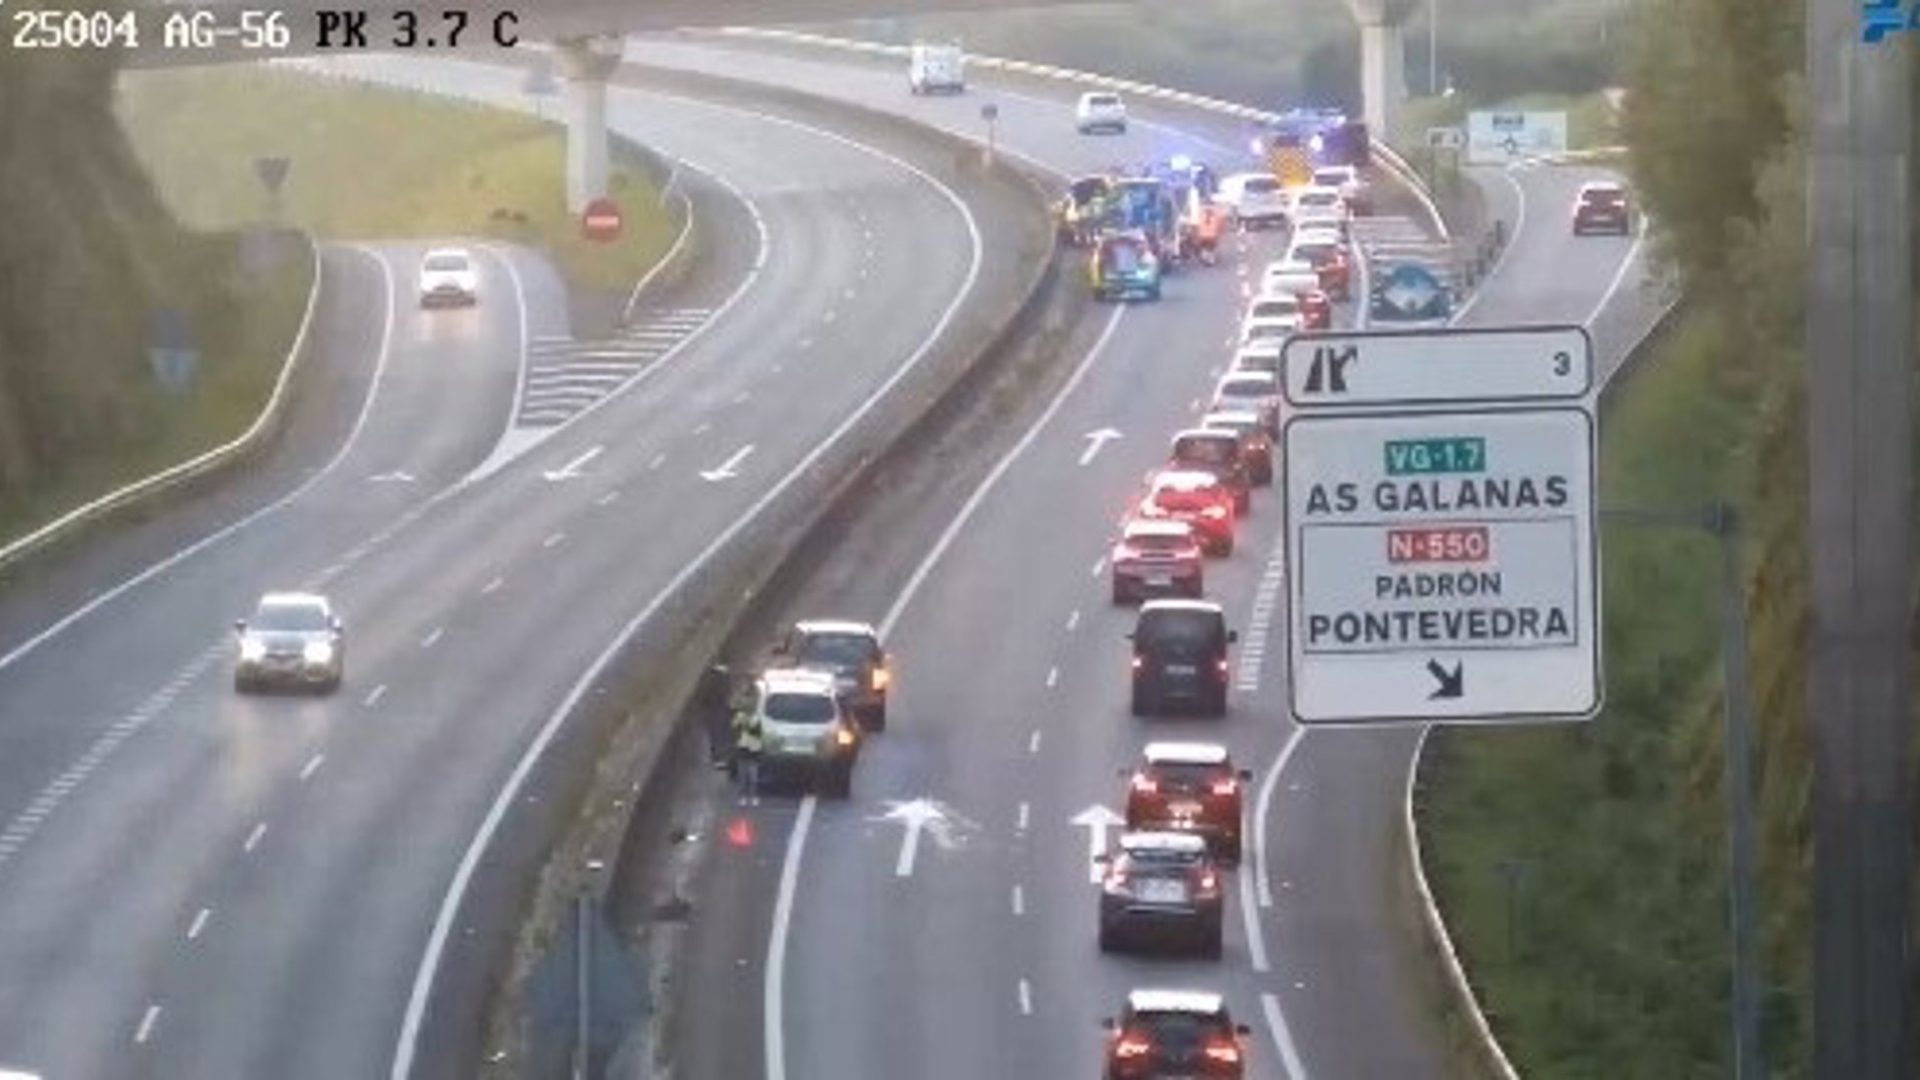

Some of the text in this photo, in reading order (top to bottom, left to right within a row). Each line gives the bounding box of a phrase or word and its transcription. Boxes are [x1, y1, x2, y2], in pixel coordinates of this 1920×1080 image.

[1553, 351, 1571, 376] 3
[1390, 440, 1481, 470] VG-1.7
[1306, 476, 1568, 514] AS GALANAS
[1390, 533, 1486, 559] N-550
[1376, 570, 1501, 599] PADRÓN
[1308, 607, 1568, 643] PONTEVEDRA
